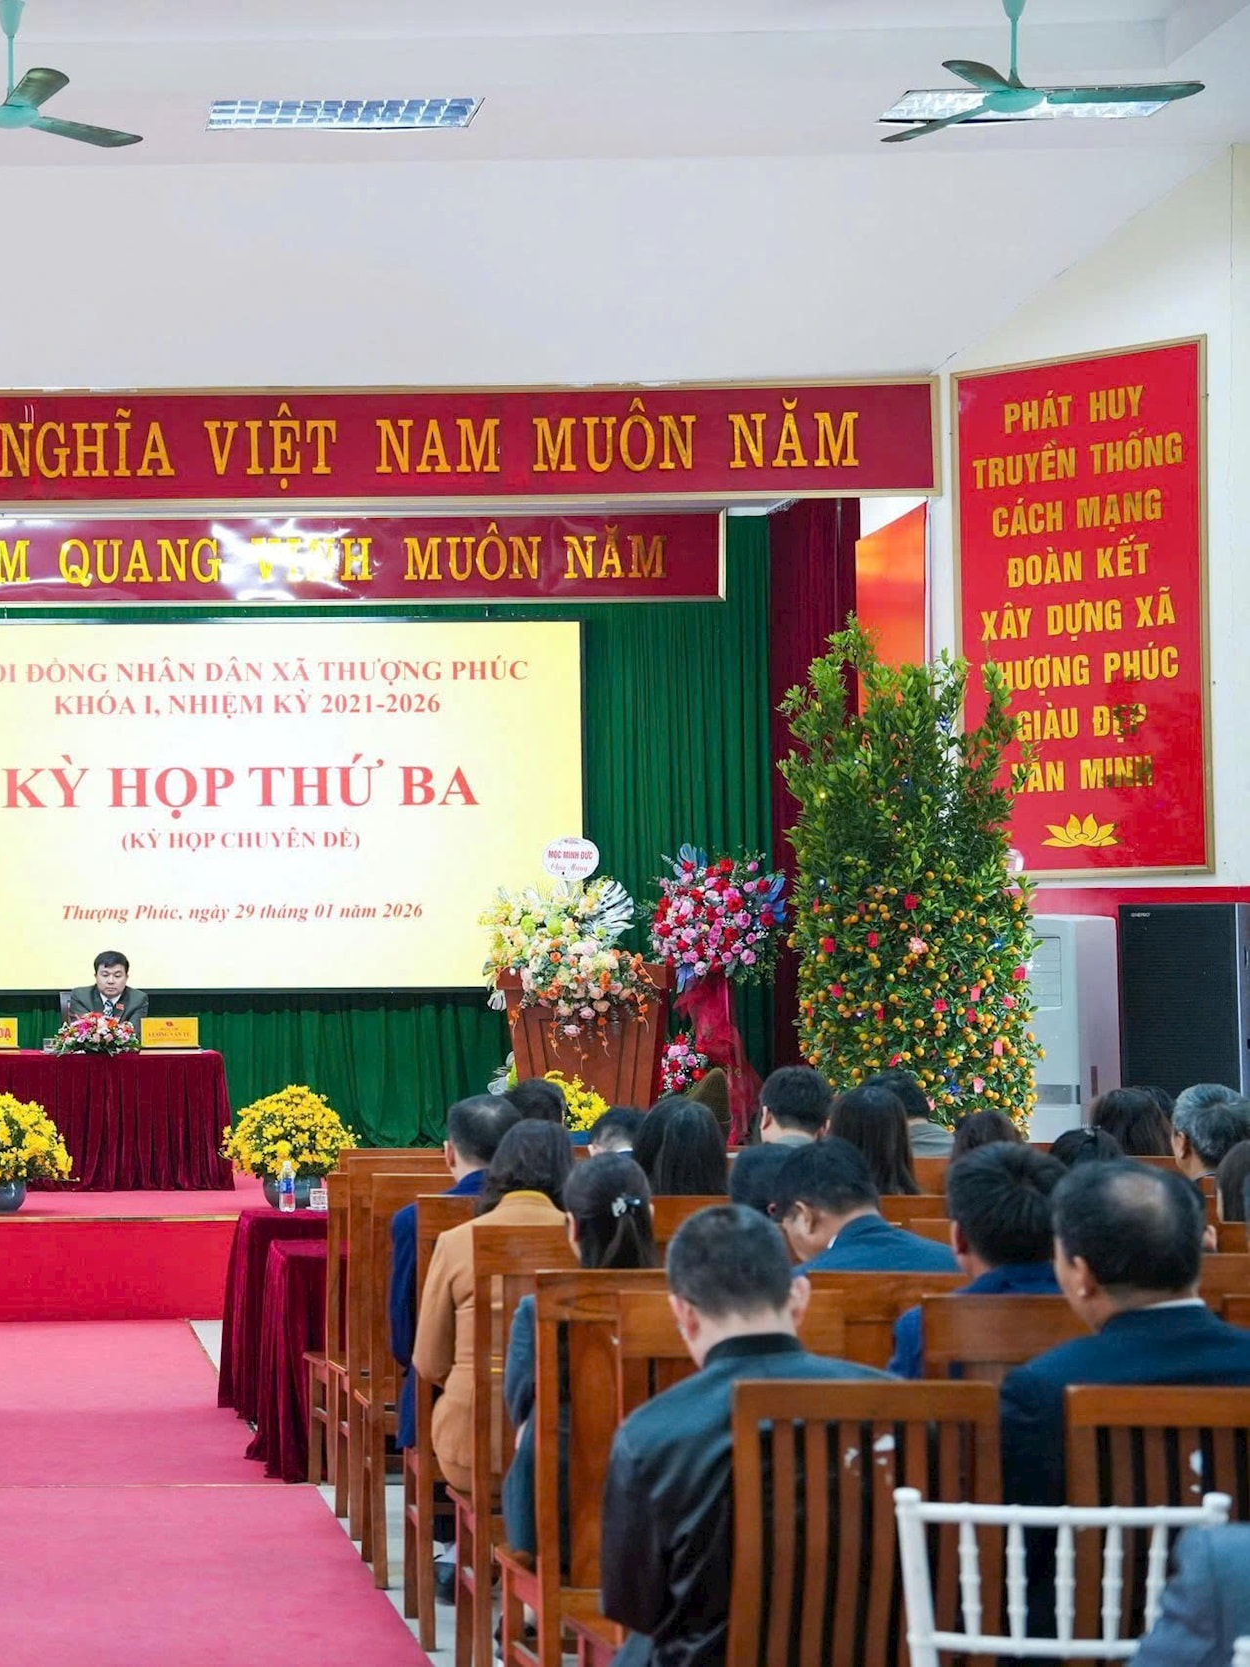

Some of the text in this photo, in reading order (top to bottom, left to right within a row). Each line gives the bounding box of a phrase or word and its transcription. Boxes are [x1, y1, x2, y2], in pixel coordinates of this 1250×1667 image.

[1004, 385, 1143, 434] PHÁT HUY
[203, 402, 336, 490] VIỆT
[376, 418, 500, 474] NAM
[532, 397, 696, 473] MUÔN
[728, 398, 859, 469] NĂM
[972, 427, 1183, 489] TRUYỀN THỐNG
[992, 488, 1162, 538] CÁCH MẠNG
[58, 537, 222, 588] QUANG
[250, 536, 374, 581] VH
[403, 522, 542, 581] MUÔN
[563, 524, 667, 580] NĂM
[1007, 534, 1150, 588] ĐOÀN KẾT
[980, 586, 1176, 642] XÂY DỰNG XÃ
[25, 657, 107, 683] ĐỒNG
[116, 656, 195, 682] NHÂN
[205, 656, 263, 682] DÂN
[272, 657, 310, 682] XÃ
[318, 658, 442, 686] THƯỢNG
[451, 655, 528, 681] PHÚC
[1103, 642, 1179, 684] PHÚC
[54, 689, 136, 715] KHÓA
[169, 692, 263, 719] NHIỆM
[273, 688, 312, 714] KỲ
[320, 693, 441, 713] 2021-2026
[1016, 702, 1147, 743] GIÀU ĐẸP
[2, 753, 479, 819] KỲ HỌP THỨ BA
[1079, 755, 1153, 790] MINH
[122, 828, 161, 851] (KỲ
[169, 832, 215, 852] HỌP
[221, 827, 316, 849] CHUYÊN
[62, 904, 129, 923] Thượng
[188, 904, 230, 922] ngày
[234, 904, 255, 919] 29
[260, 903, 309, 921] tháng
[314, 904, 334, 919] 01
[340, 904, 377, 919] năm
[382, 903, 424, 918] 2026
